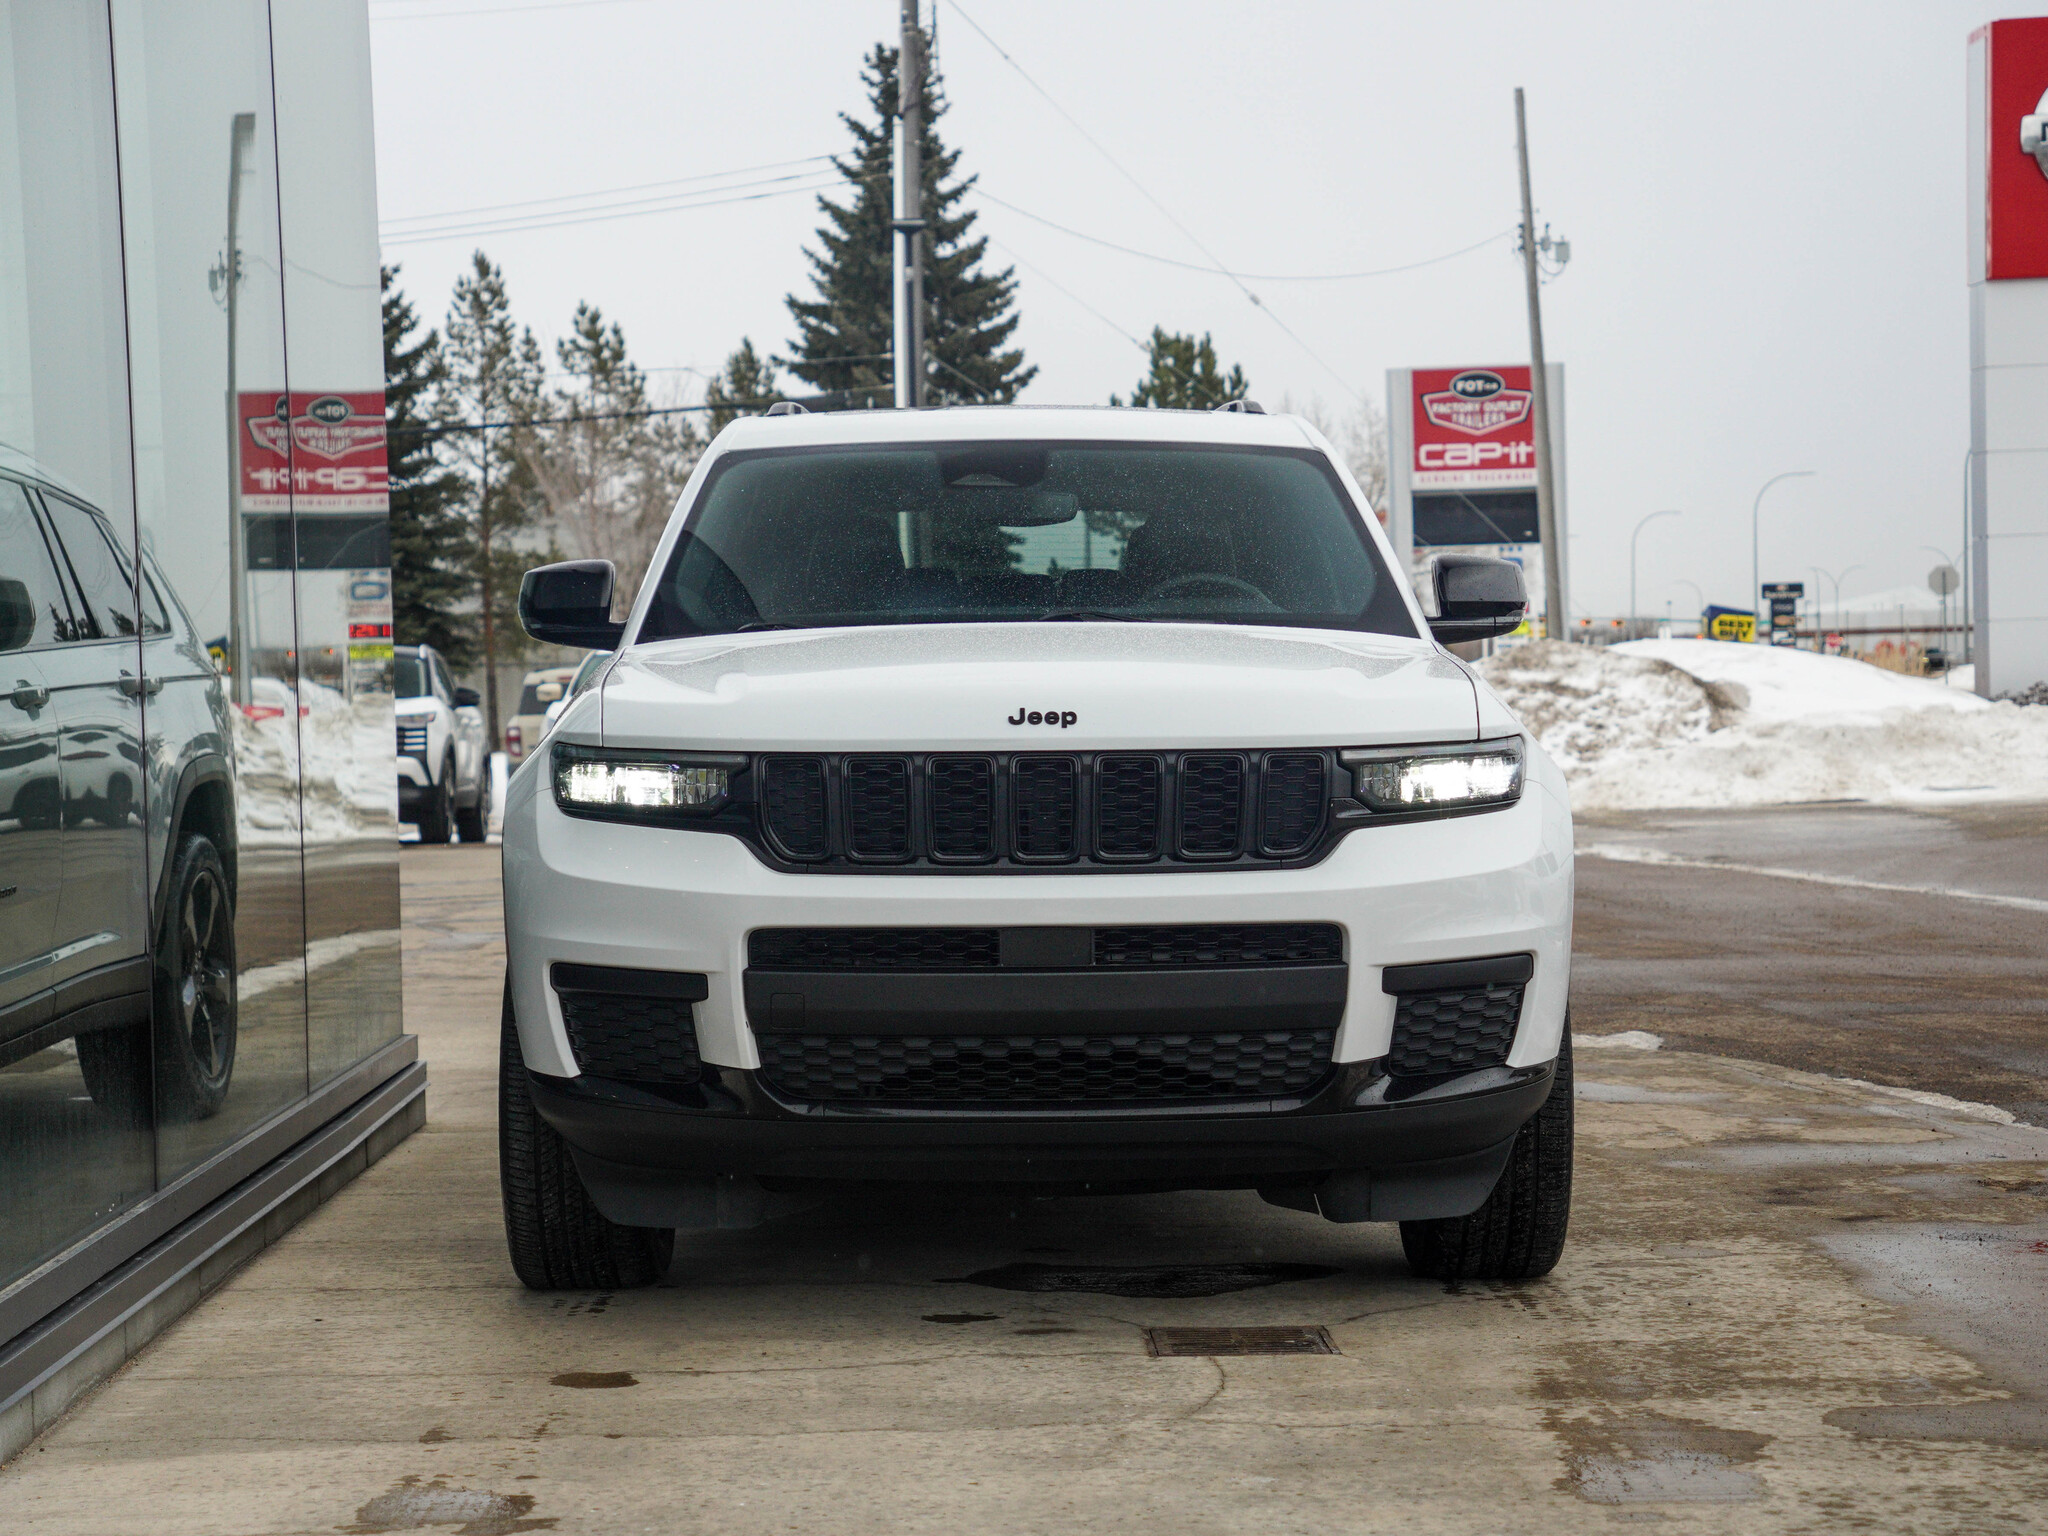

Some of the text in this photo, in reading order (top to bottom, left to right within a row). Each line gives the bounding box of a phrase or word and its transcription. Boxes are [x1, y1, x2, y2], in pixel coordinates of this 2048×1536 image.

[1432, 401, 1523, 414] FACTORY OUTLET
[1452, 413, 1506, 428] TRAILERS
[1718, 620, 1753, 628] BEST
[1719, 629, 1749, 638] BUY
[1008, 707, 1077, 728] Jeep
